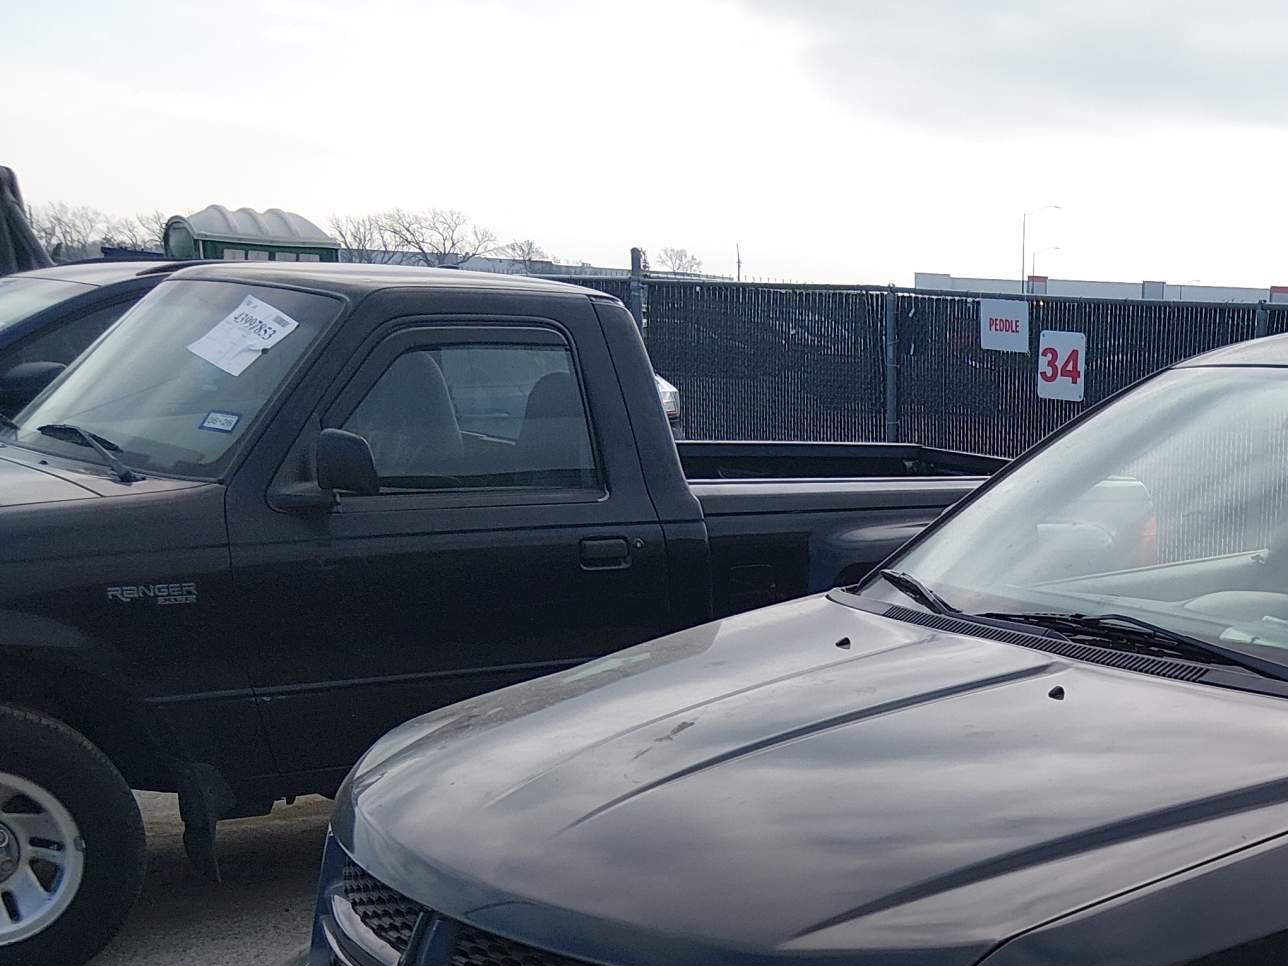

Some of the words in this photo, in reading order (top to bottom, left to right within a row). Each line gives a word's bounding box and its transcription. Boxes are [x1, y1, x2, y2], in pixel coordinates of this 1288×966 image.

[989, 318, 1020, 333] PEDDLE
[1039, 347, 1080, 384] 34
[106, 583, 198, 602] RANGER
